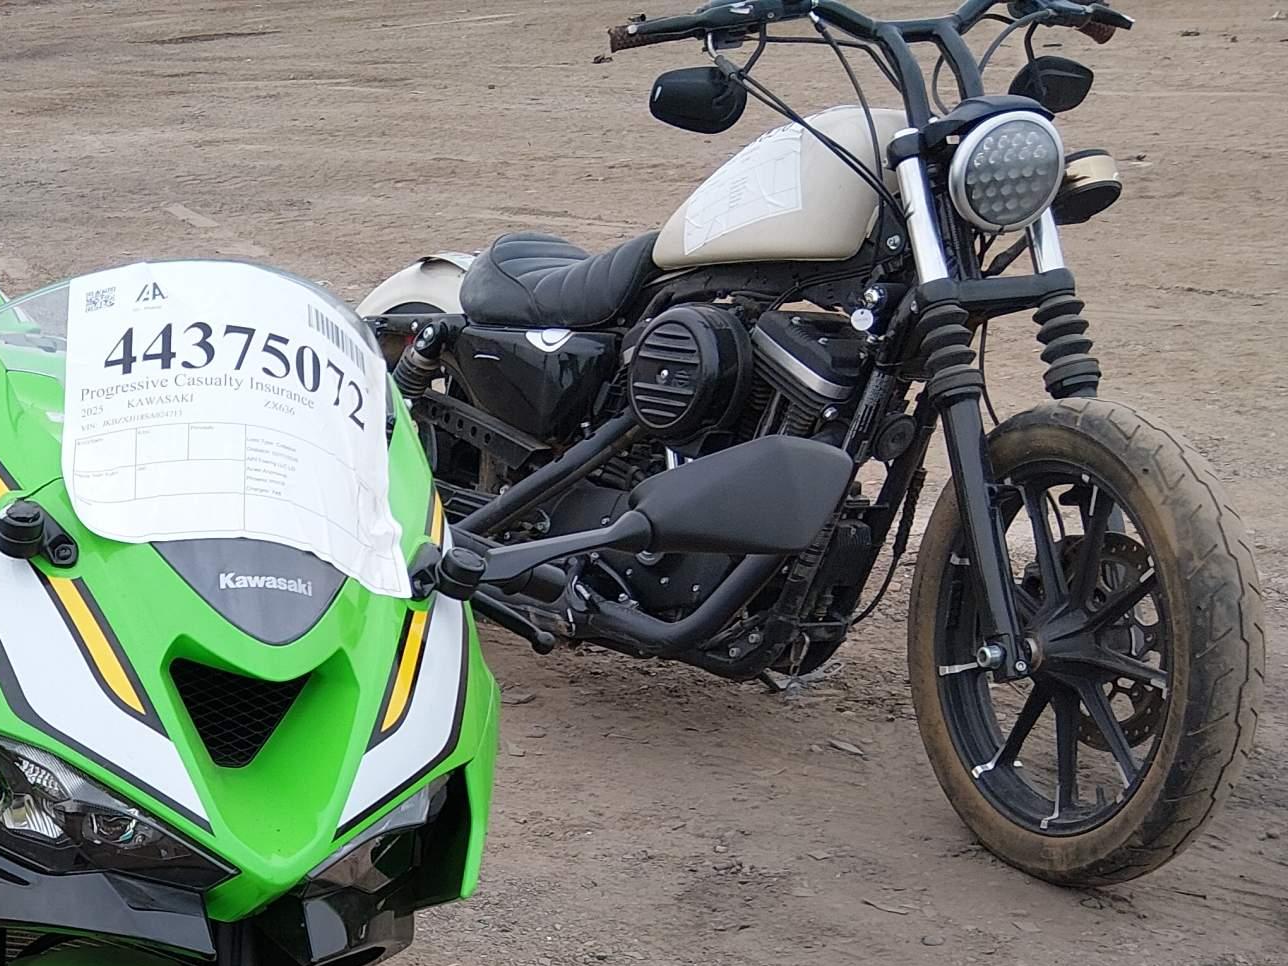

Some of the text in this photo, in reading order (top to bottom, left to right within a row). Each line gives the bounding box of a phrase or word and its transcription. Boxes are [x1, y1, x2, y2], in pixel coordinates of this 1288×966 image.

[80, 372, 316, 409] Progressive Casualty Insurance
[103, 321, 366, 432] 44375072
[81, 405, 104, 418] 2025
[127, 393, 194, 409] KAWASAKI
[219, 572, 312, 597] Kawasaki
